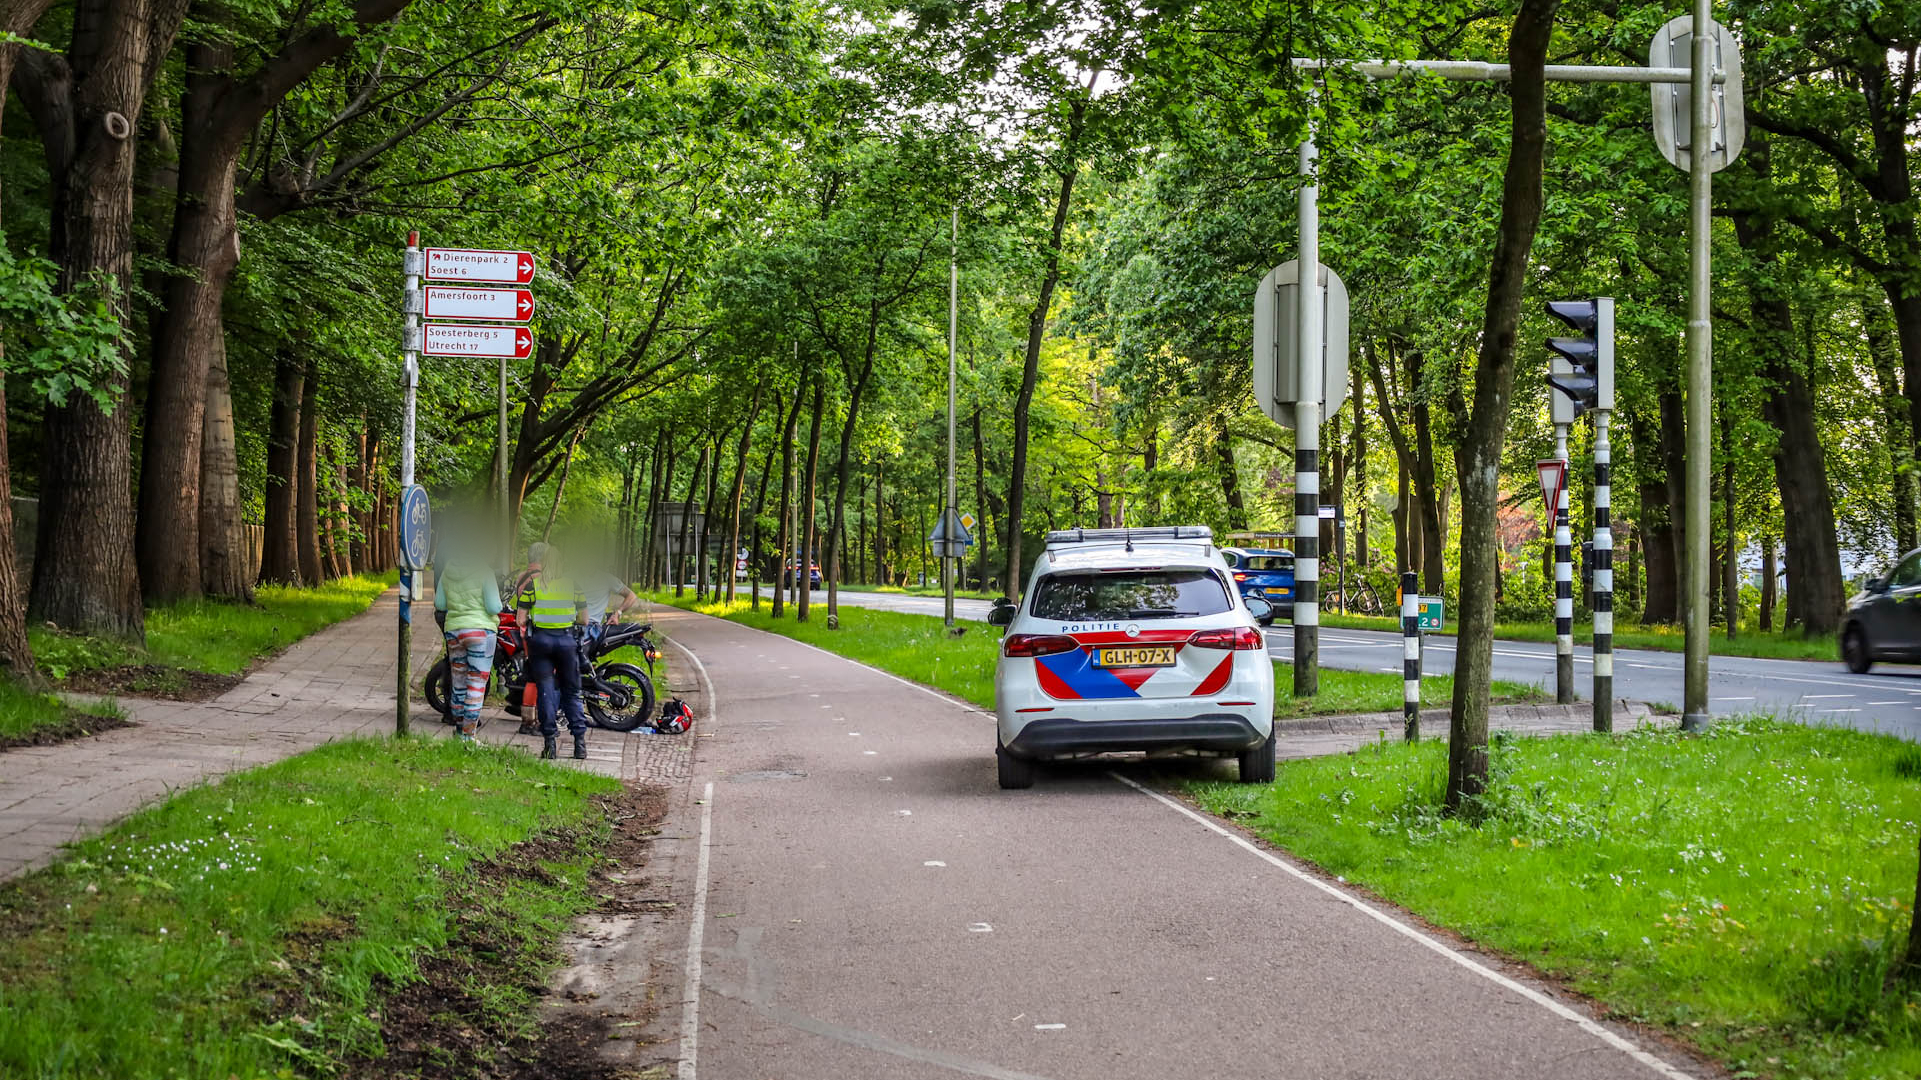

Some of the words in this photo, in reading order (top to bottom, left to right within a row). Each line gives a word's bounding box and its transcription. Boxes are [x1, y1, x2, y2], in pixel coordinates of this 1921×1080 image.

[443, 253, 499, 264] Dierenpark
[430, 266, 458, 274] Soest
[430, 291, 487, 301] Amersfoort
[429, 328, 490, 339] Soesterberg
[428, 341, 466, 350] Utrecht
[1061, 622, 1120, 633] POLITIE
[1105, 649, 1171, 664] GLH-07-X
